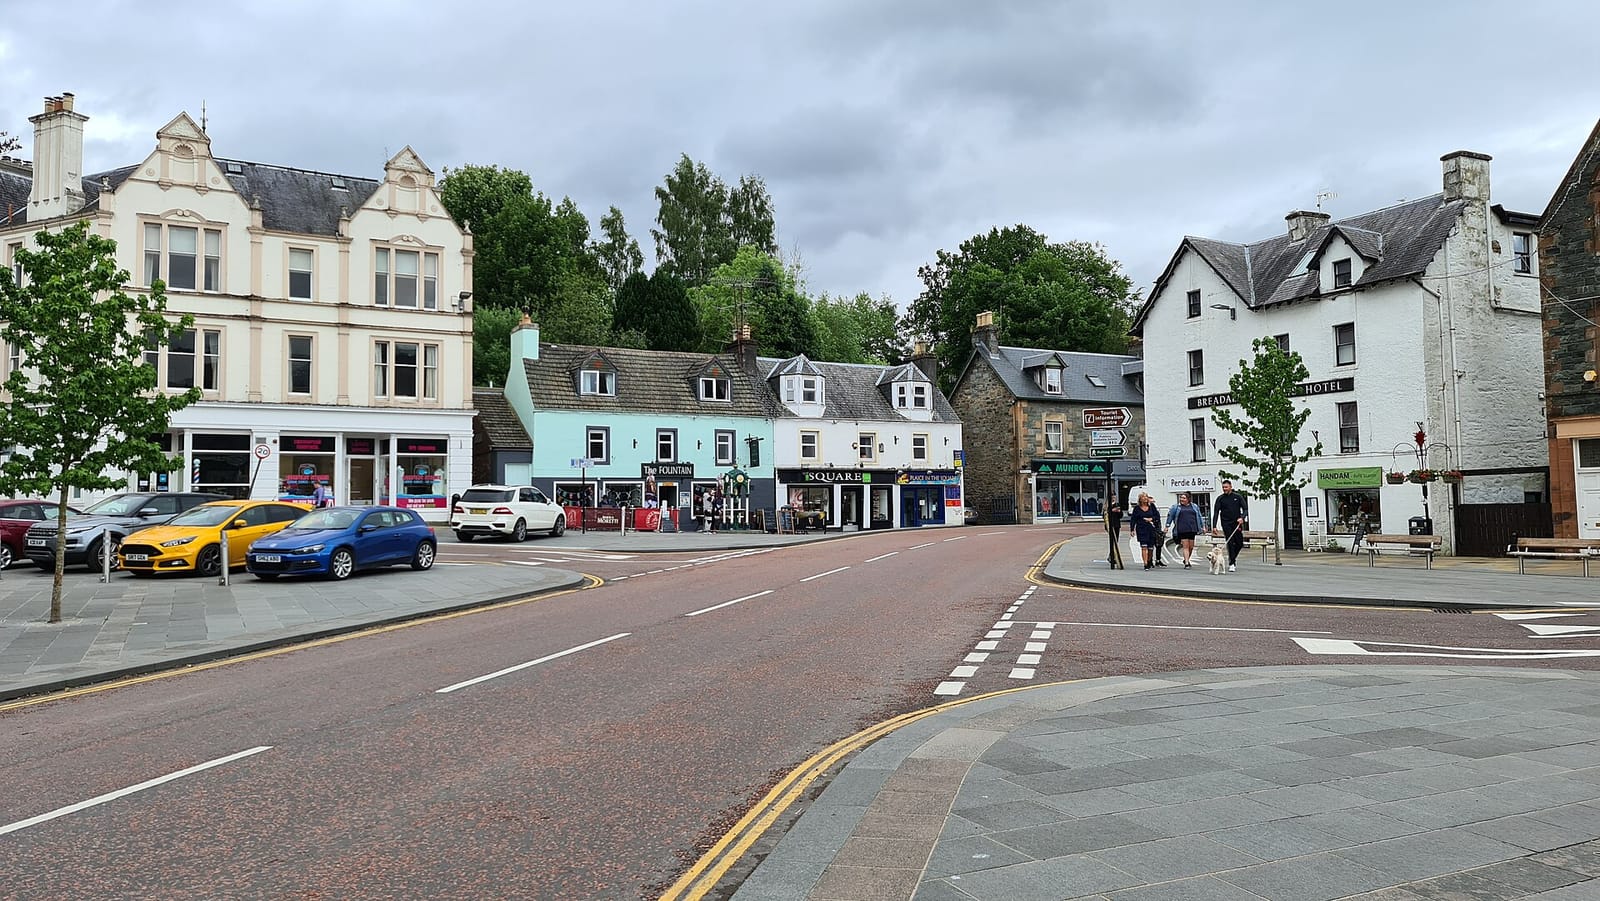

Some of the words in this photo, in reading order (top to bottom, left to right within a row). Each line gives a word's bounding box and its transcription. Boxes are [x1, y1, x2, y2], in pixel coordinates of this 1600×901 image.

[1305, 381, 1343, 394] HOTEL
[257, 447, 269, 456] 20
[643, 466, 657, 475] The
[659, 466, 692, 475] FOUNTAIN
[1056, 464, 1089, 472] MUNROS
[809, 472, 862, 482] SQUARE
[1320, 472, 1350, 480] HANDAM
[1171, 478, 1190, 487] Perdie
[1191, 478, 1196, 486] &
[1197, 477, 1210, 486] Boo
